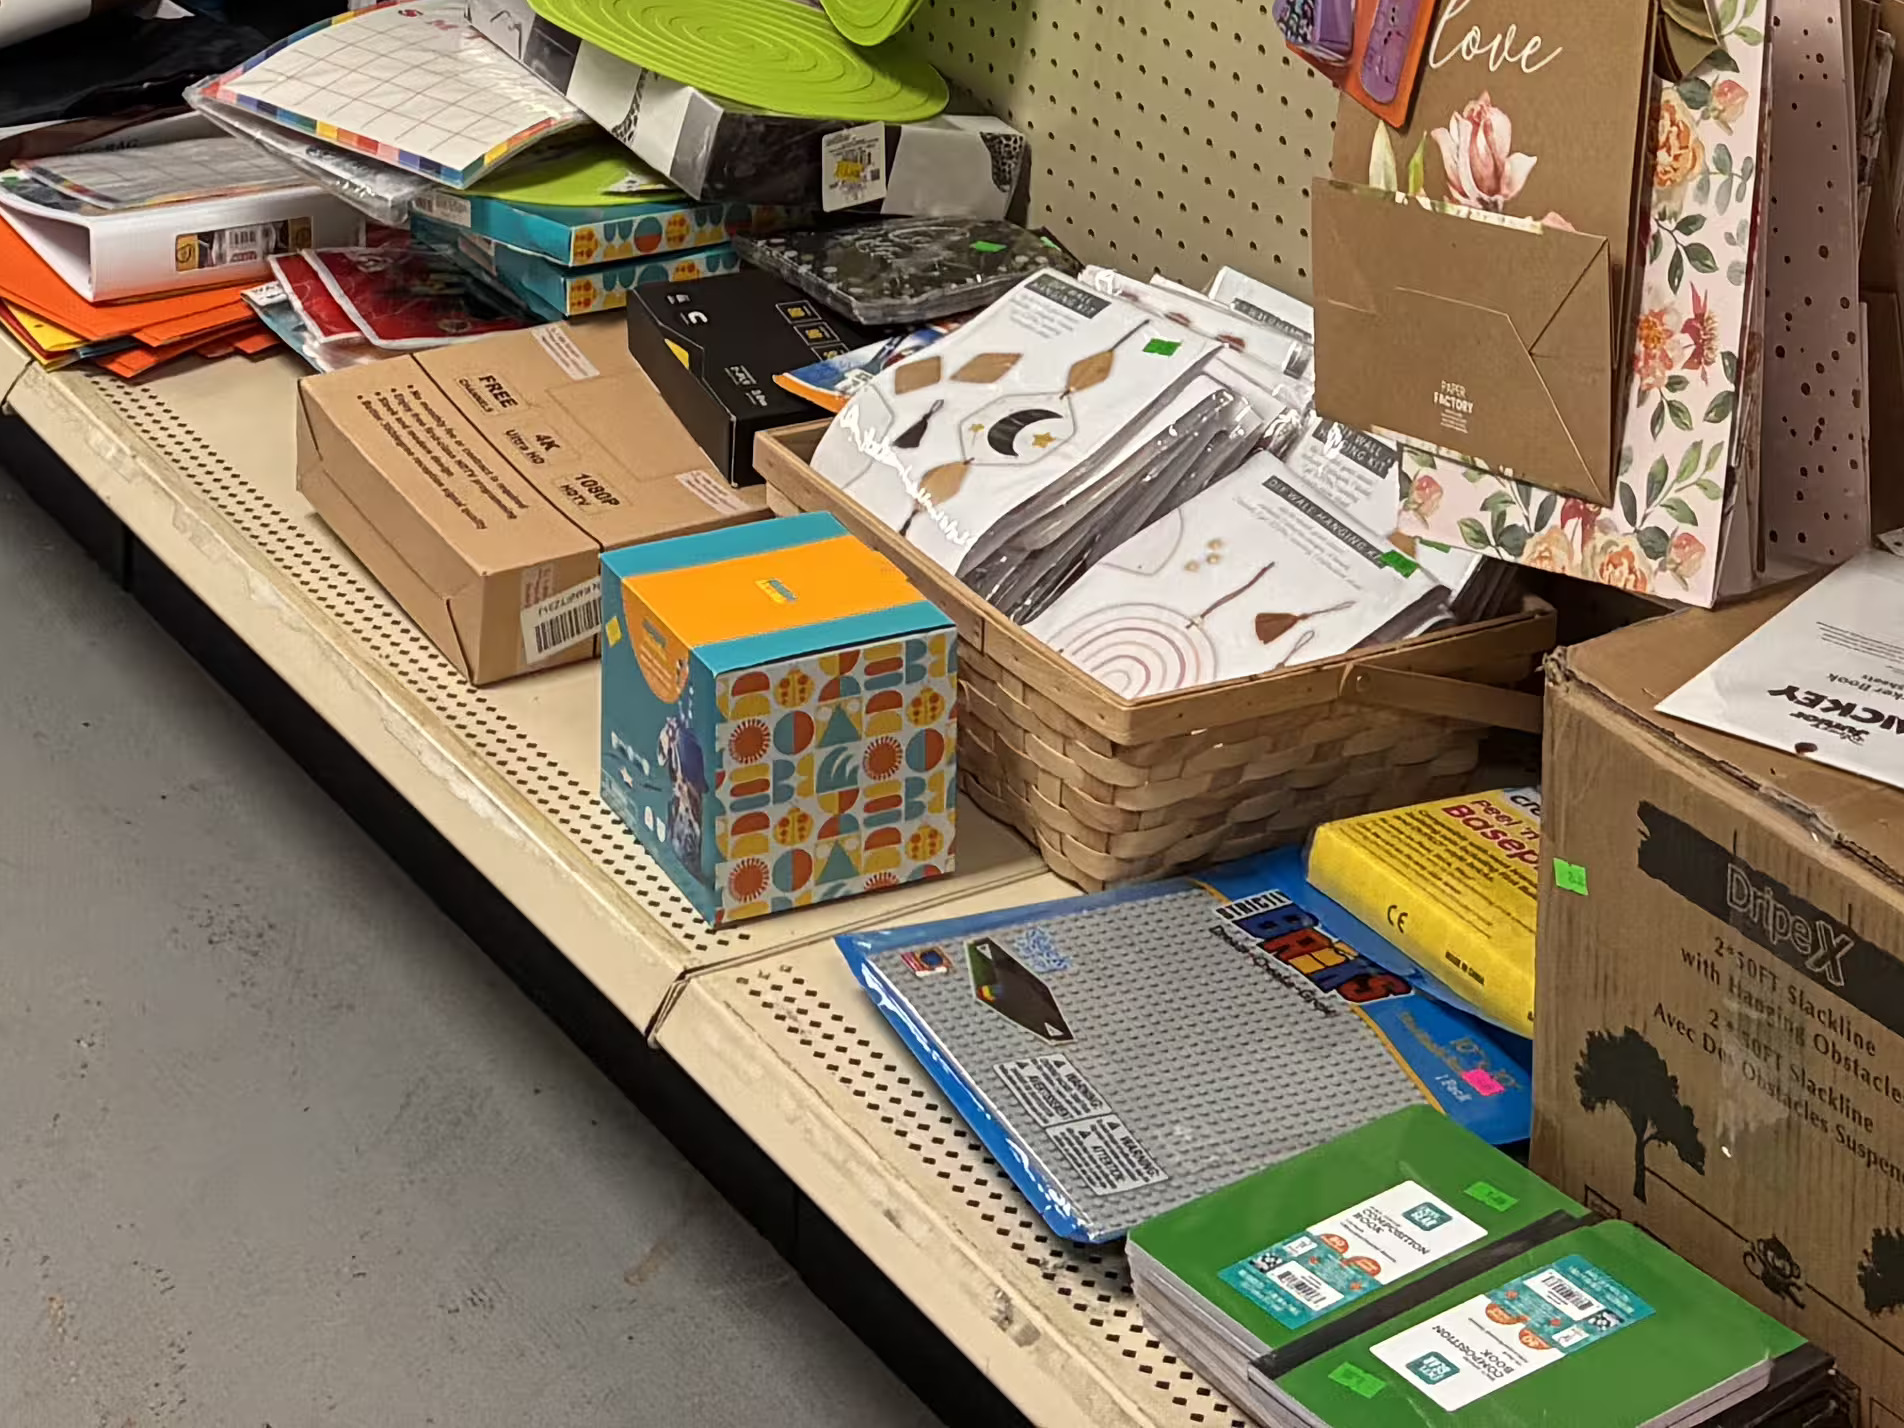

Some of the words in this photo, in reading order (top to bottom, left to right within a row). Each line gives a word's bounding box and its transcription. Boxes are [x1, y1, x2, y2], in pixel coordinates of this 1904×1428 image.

[478, 374, 519, 410] FREE
[1433, 390, 1474, 415] FACTORY
[1441, 379, 1467, 399] PAPER
[504, 428, 526, 450] Ultra
[535, 432, 561, 453] 4K
[559, 483, 592, 510] HDTV
[575, 472, 621, 509] 1080P
[1827, 671, 1873, 693] Book
[1469, 798, 1522, 828] Peel
[1726, 862, 1855, 987] DripeX
[1680, 947, 1721, 987] with
[1728, 975, 1806, 1048] Hanging
[1787, 984, 1877, 1058] Slackline
[1653, 1000, 1697, 1045] Avec
[1741, 1060, 1829, 1134] Obstacles
[1707, 1008, 1720, 1030] 2
[1789, 1061, 1875, 1134] Slackline
[1119, 1135, 1161, 1179] WARNING
[1352, 1211, 1385, 1235] BOOK
[1362, 1207, 1431, 1257] COMPOSITION
[1431, 1324, 1505, 1379] COMPOSITION
[1481, 1348, 1515, 1375] BOOK
